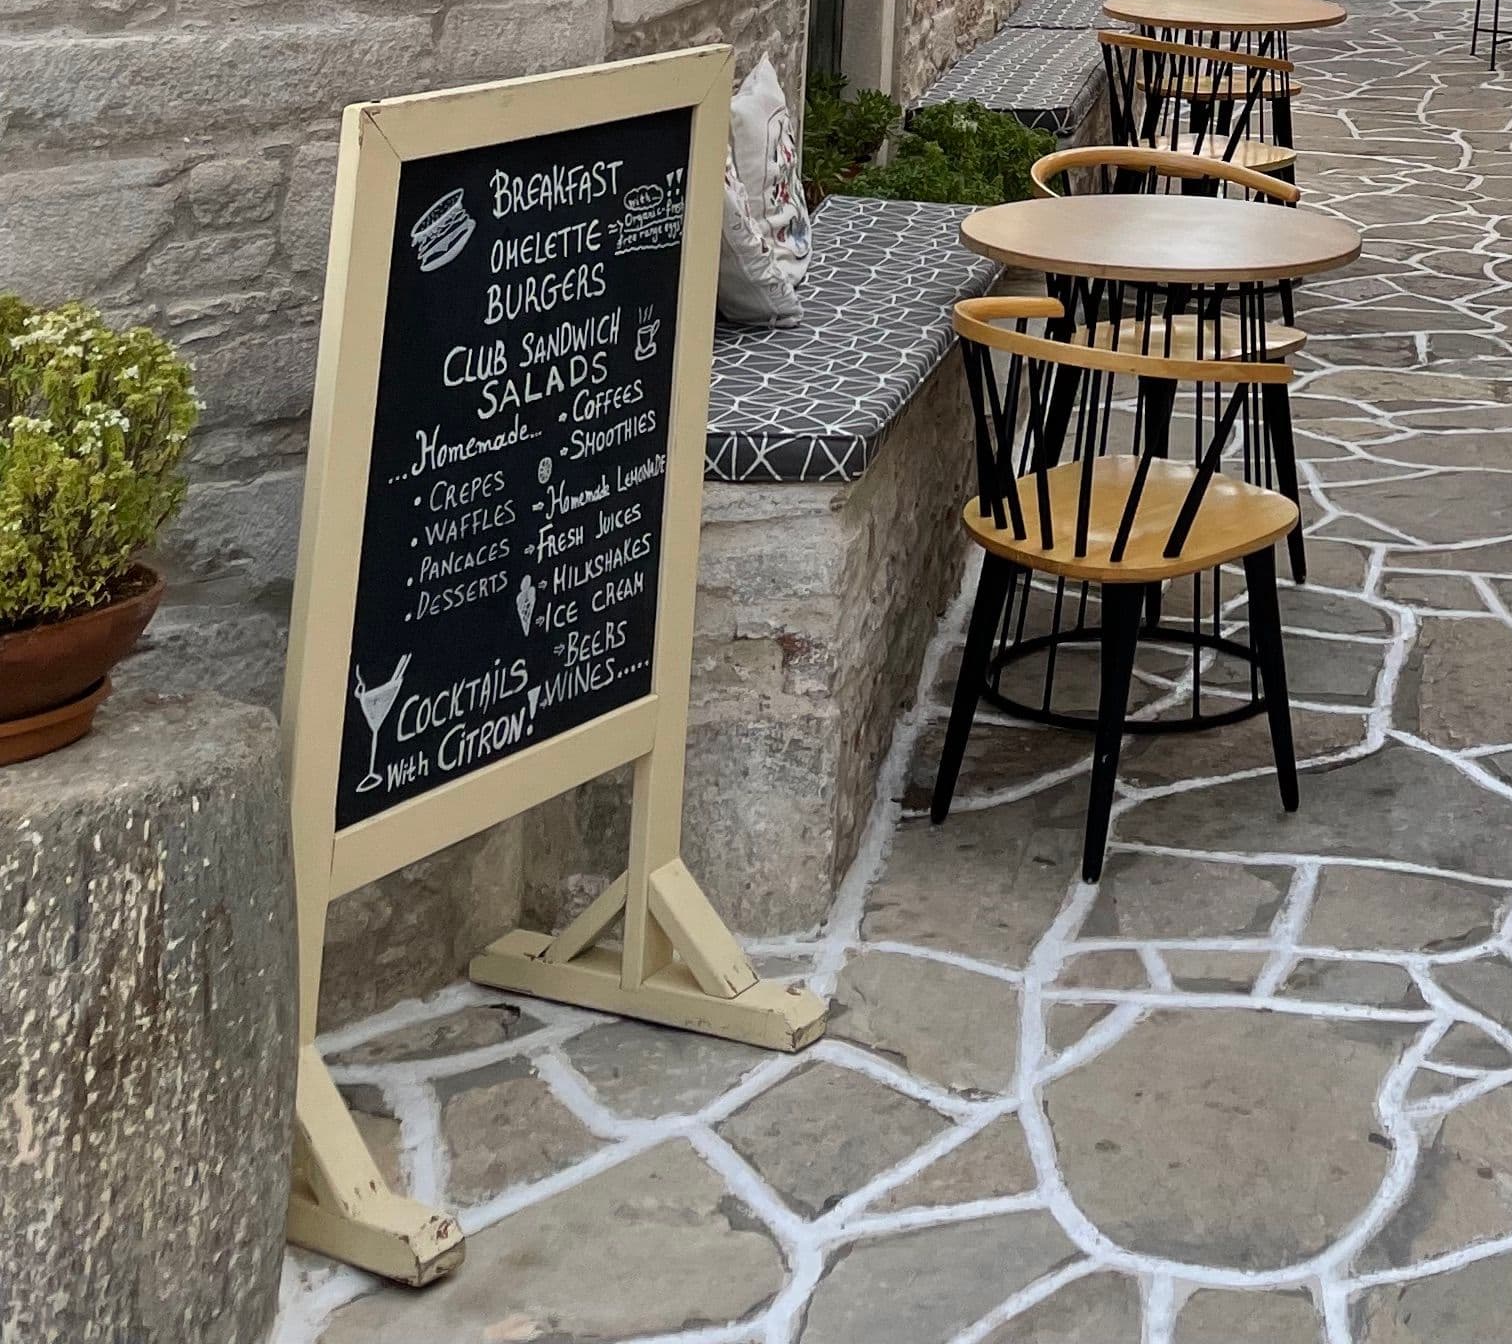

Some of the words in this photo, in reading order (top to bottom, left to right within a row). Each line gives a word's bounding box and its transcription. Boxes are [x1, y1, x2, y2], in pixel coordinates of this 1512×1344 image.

[489, 159, 624, 220] BREAKFAST
[489, 218, 603, 274] OMELETTE
[483, 262, 607, 325] BURGERS
[443, 339, 508, 387] CLUB
[519, 305, 621, 368] SANDWICH
[477, 351, 608, 420] SALADS
[572, 378, 644, 423] COFFEES
[569, 409, 656, 460] SMOOTHIES
[429, 470, 506, 512] CREPES
[424, 499, 516, 547] WAFFLES
[536, 523, 584, 564] FRESH
[595, 503, 642, 539] JUICES
[419, 538, 510, 584] PANCACES
[553, 532, 652, 595] MILKSHAKES
[416, 570, 509, 621] DESSERTS
[545, 601, 579, 633] ICE
[591, 570, 644, 612] CREAM
[563, 620, 628, 667] BEERS
[387, 750, 429, 792] With
